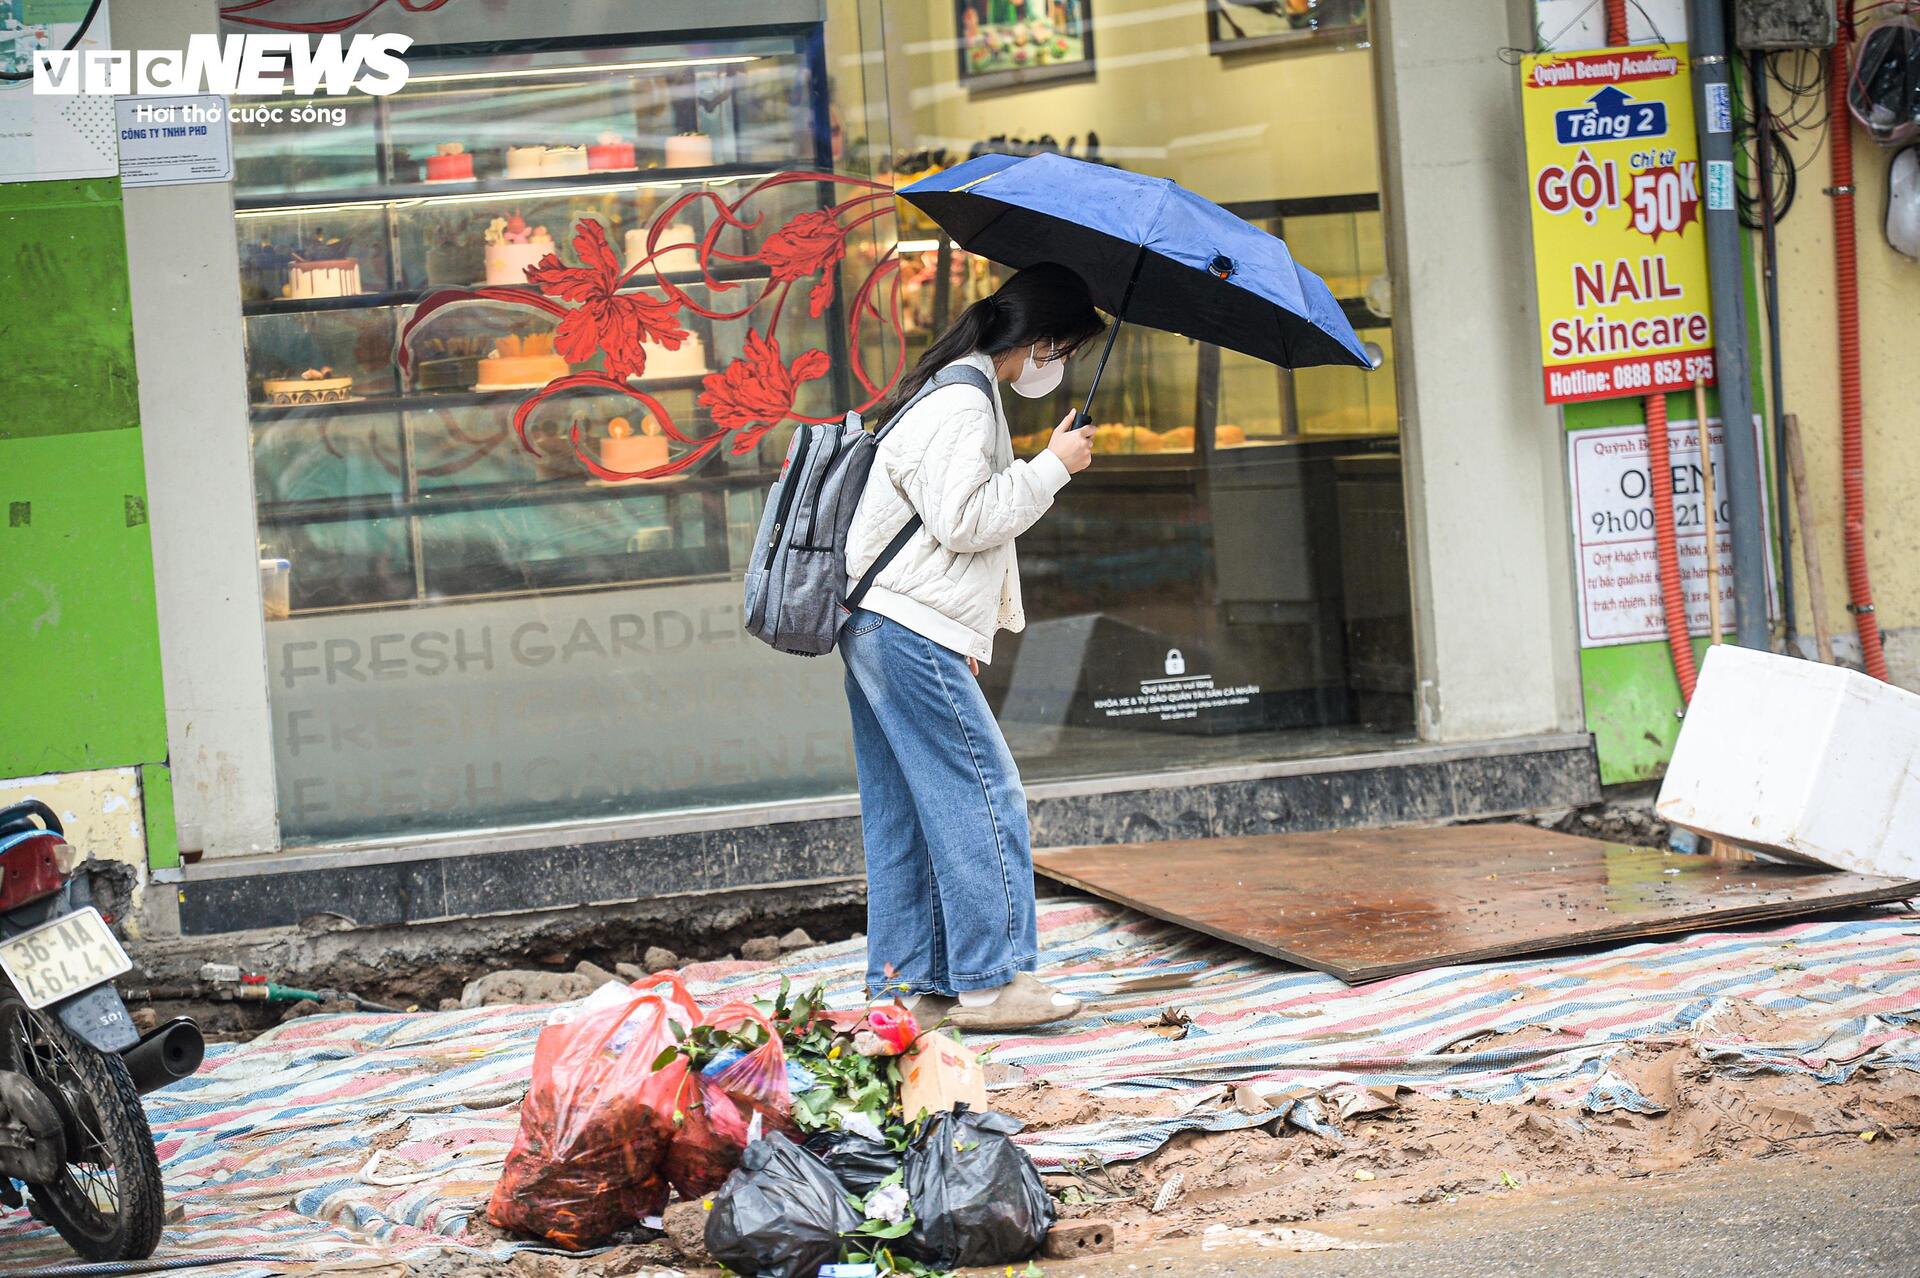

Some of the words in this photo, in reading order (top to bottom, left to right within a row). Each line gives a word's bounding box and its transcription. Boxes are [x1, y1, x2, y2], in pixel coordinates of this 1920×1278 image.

[1576, 59, 1620, 81] Beauty
[1622, 55, 1677, 78] Academy
[121, 126, 147, 140] CÔNG
[149, 128, 159, 139] TY
[162, 127, 186, 138] TNHH
[1568, 108, 1630, 139] Tầng
[1638, 109, 1655, 133] 2
[1630, 150, 1654, 169] Chỉ
[1655, 148, 1676, 165] từ
[1536, 149, 1619, 226] GỘI
[1574, 257, 1681, 308] NAIL
[1550, 313, 1709, 359] Skincare
[1549, 374, 1611, 398] Hotline:
[1613, 365, 1651, 389] 0888
[1653, 360, 1684, 384] 852
[1685, 356, 1714, 381] 525
[1620, 462, 1717, 499] OEN
[281, 625, 494, 689] FRESH
[510, 603, 748, 667] GARDE
[13, 919, 94, 968] 36-AA
